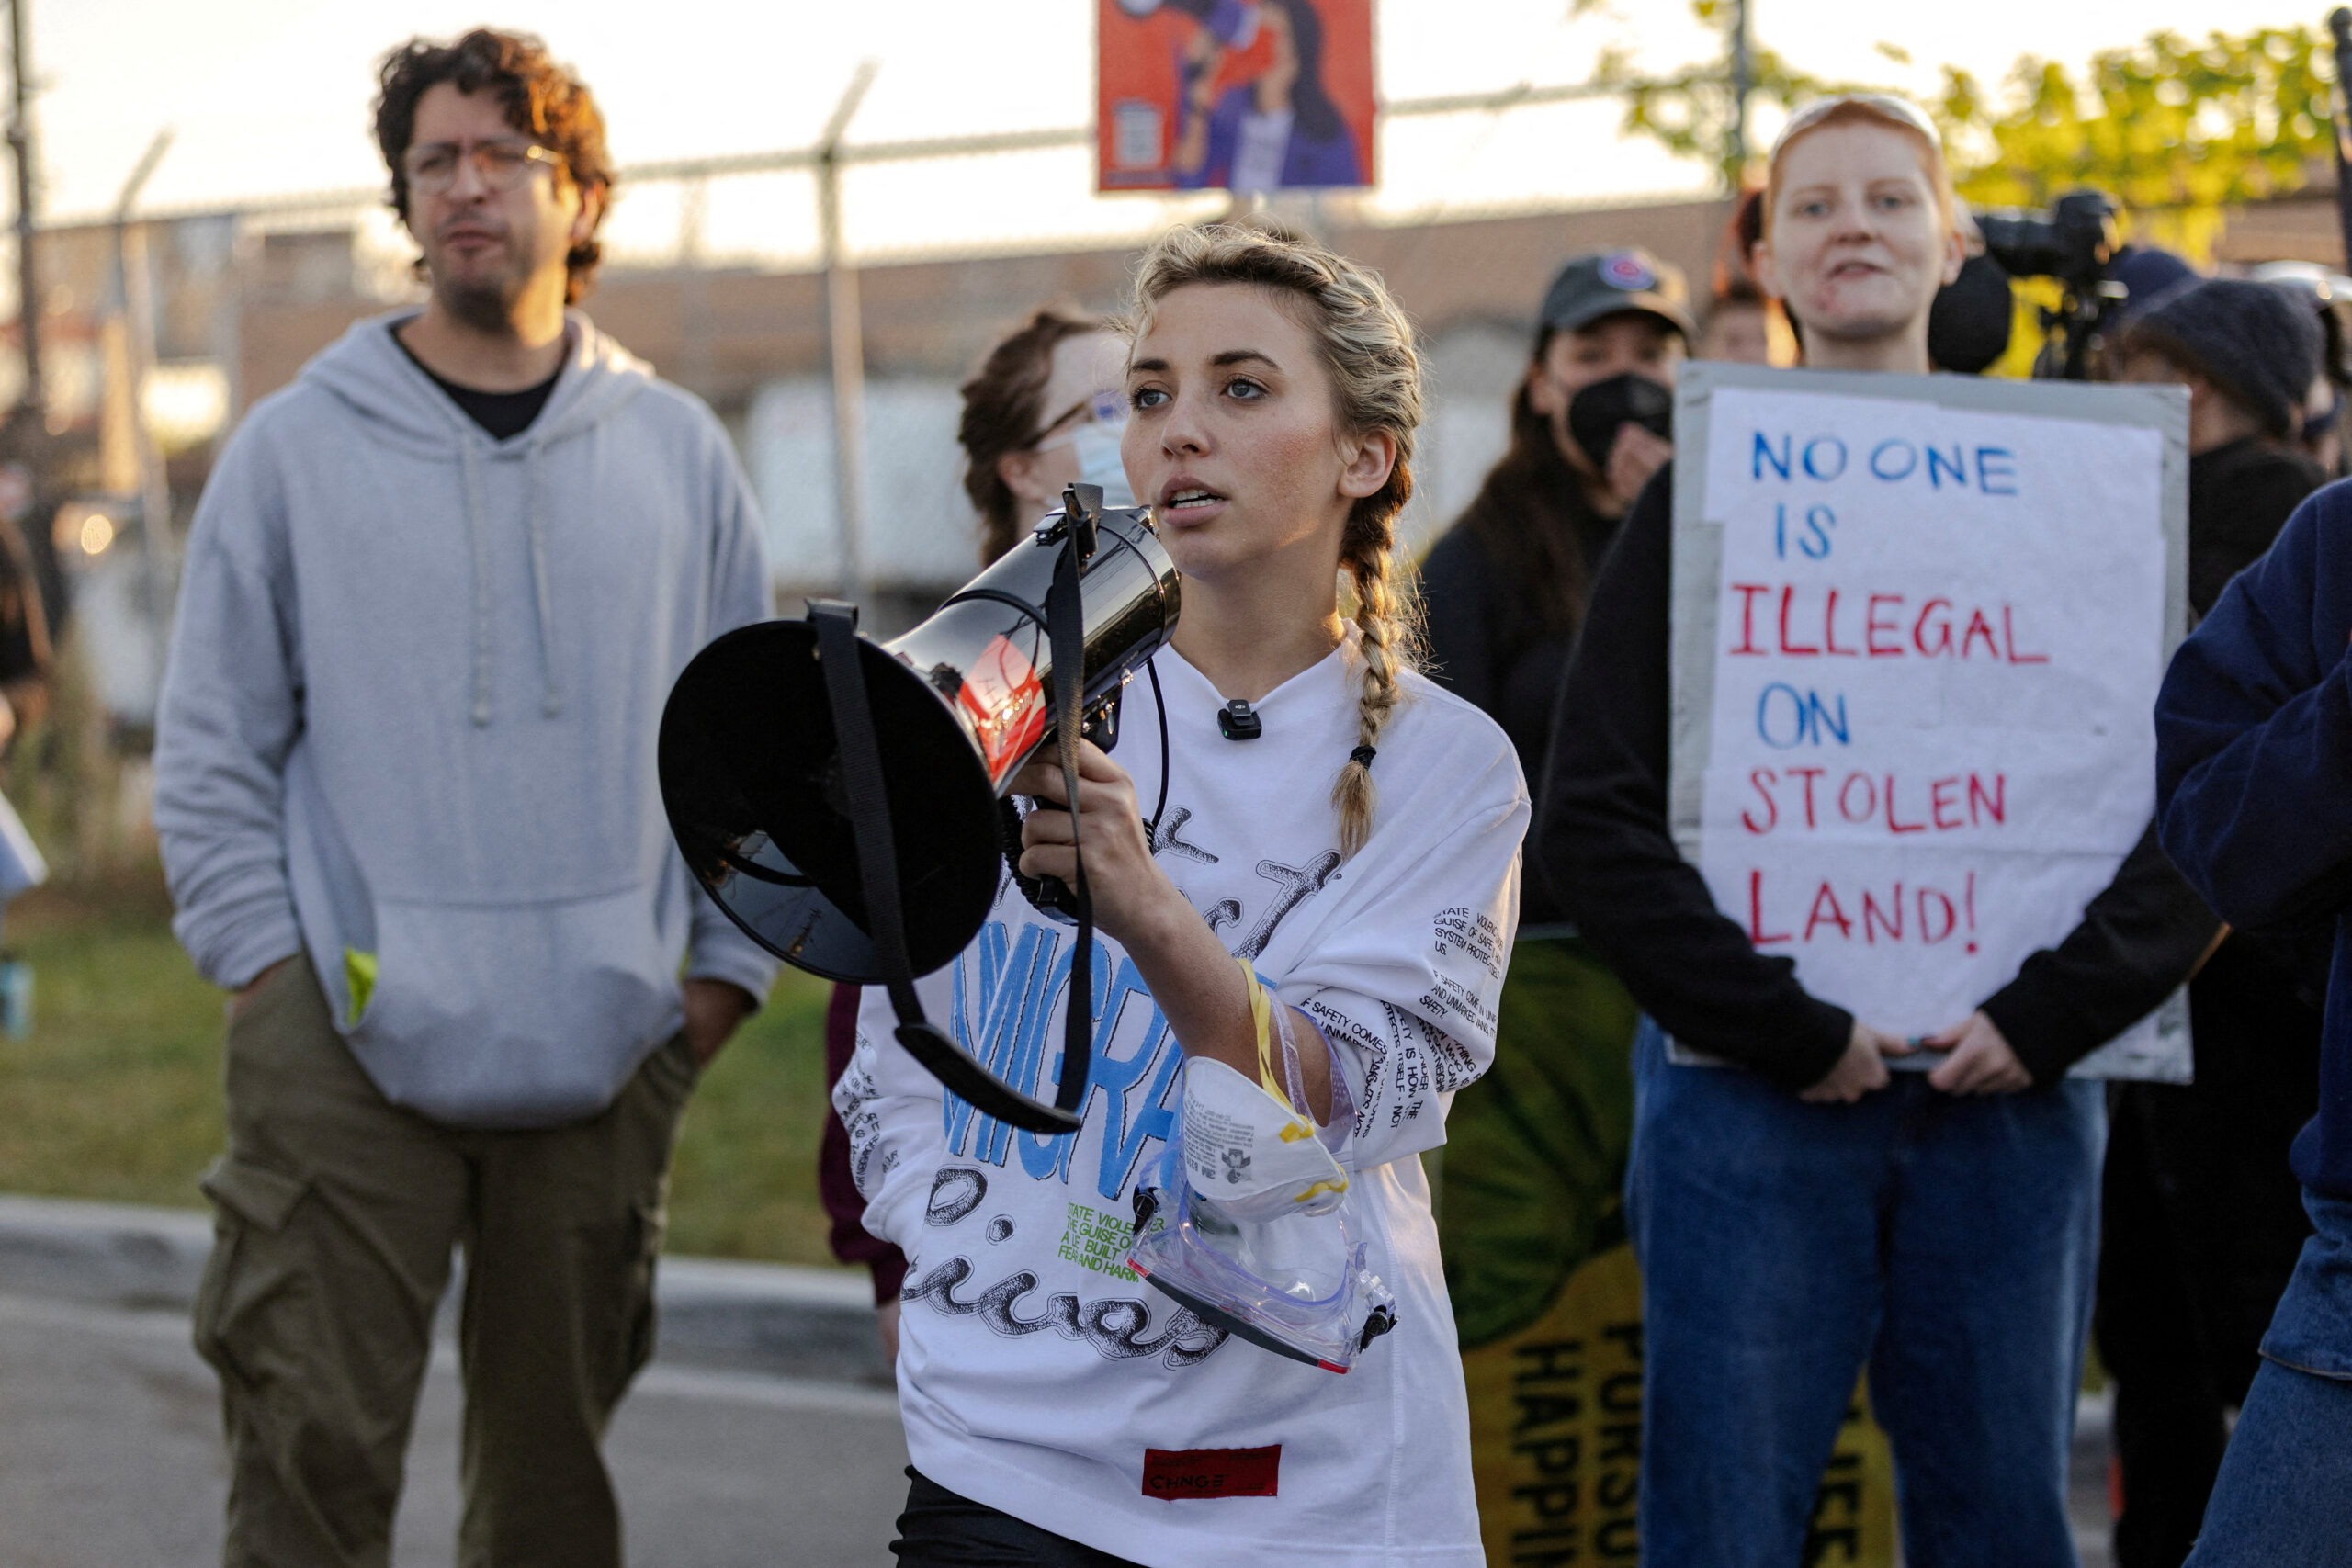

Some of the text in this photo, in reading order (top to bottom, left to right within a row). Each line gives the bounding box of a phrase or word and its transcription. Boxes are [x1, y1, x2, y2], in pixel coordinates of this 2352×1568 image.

[1752, 431, 2019, 496] NO ONE
[1775, 502, 1837, 560] IS
[1728, 583, 2051, 665] ILLEGAL
[1756, 682, 1851, 750] ON
[1742, 767, 2007, 835] STOLEN
[1433, 918, 1467, 932] GUISE
[1748, 869, 1979, 954] LAND!
[1435, 927, 1468, 951] SYSTEM
[1312, 1001, 1351, 1027] SAFETY
[1351, 1023, 1388, 1055] COMES
[1079, 1222, 1118, 1246] GUISE
[1084, 1239, 1122, 1261] BUILT
[1098, 1212, 1135, 1235] VIOLE
[1102, 1261, 1140, 1283] HARM
